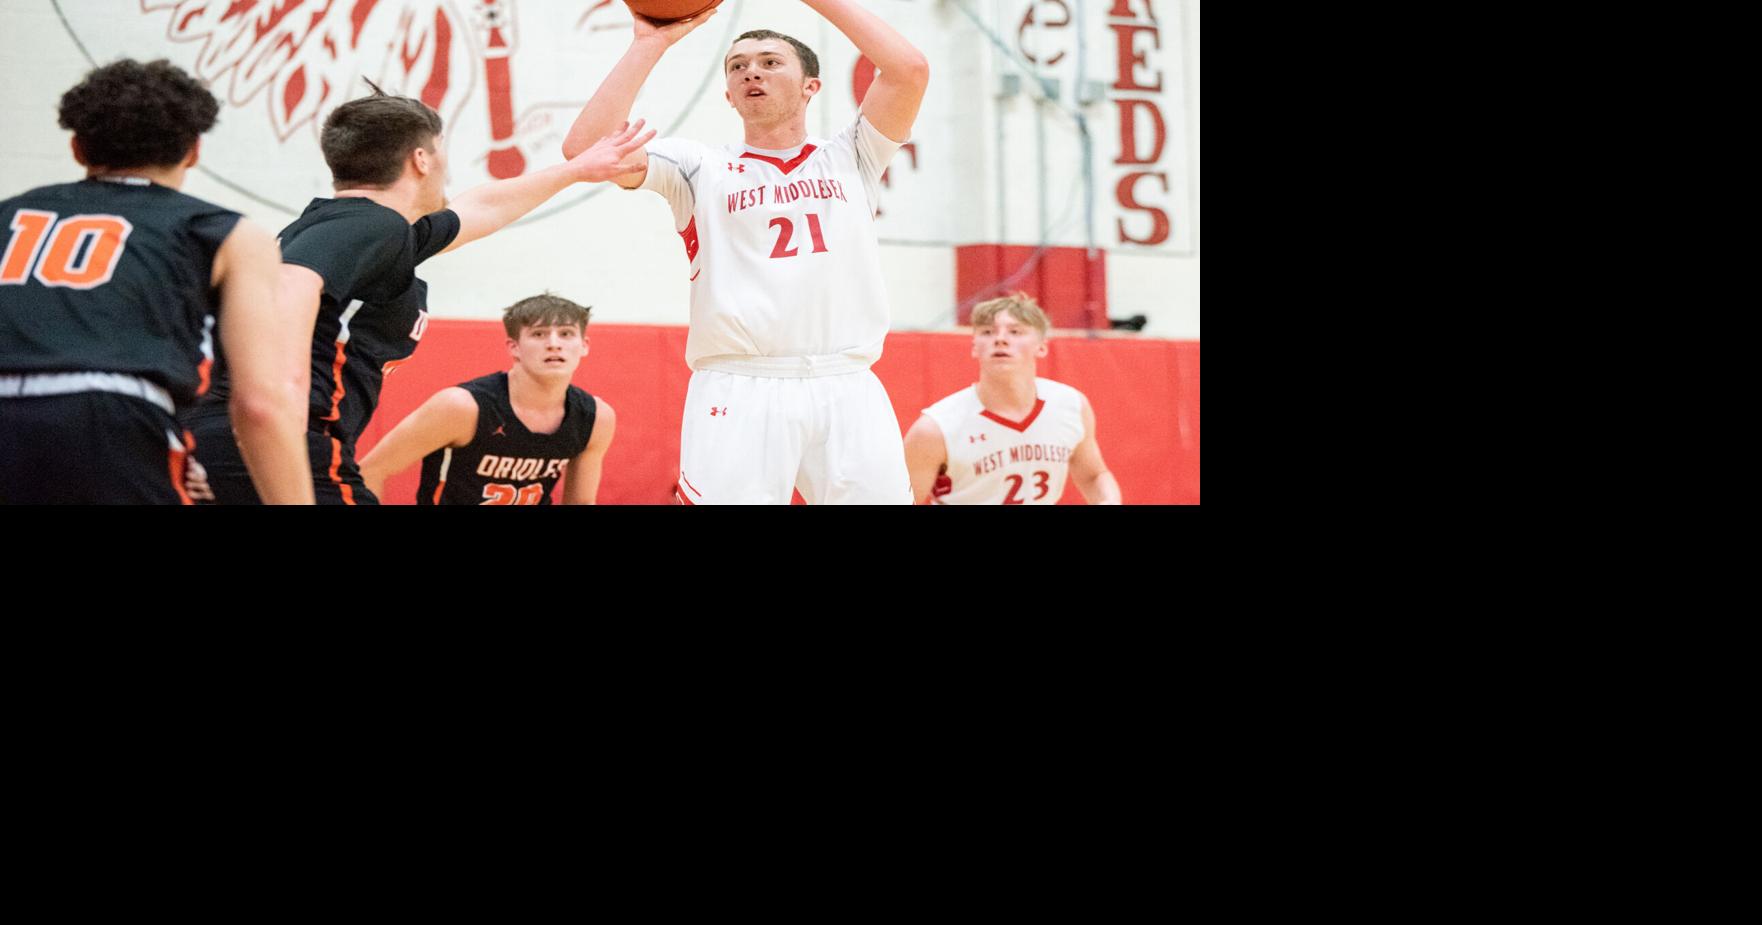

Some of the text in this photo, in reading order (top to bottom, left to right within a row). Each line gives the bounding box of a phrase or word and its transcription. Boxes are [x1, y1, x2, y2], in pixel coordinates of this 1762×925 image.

[1108, 0, 1170, 246] EDS
[727, 178, 848, 214] WEST MIDDLESEX
[0, 208, 134, 290] 10
[768, 213, 829, 259] 21
[973, 450, 1003, 476] WEST
[1002, 470, 1050, 505] 23
